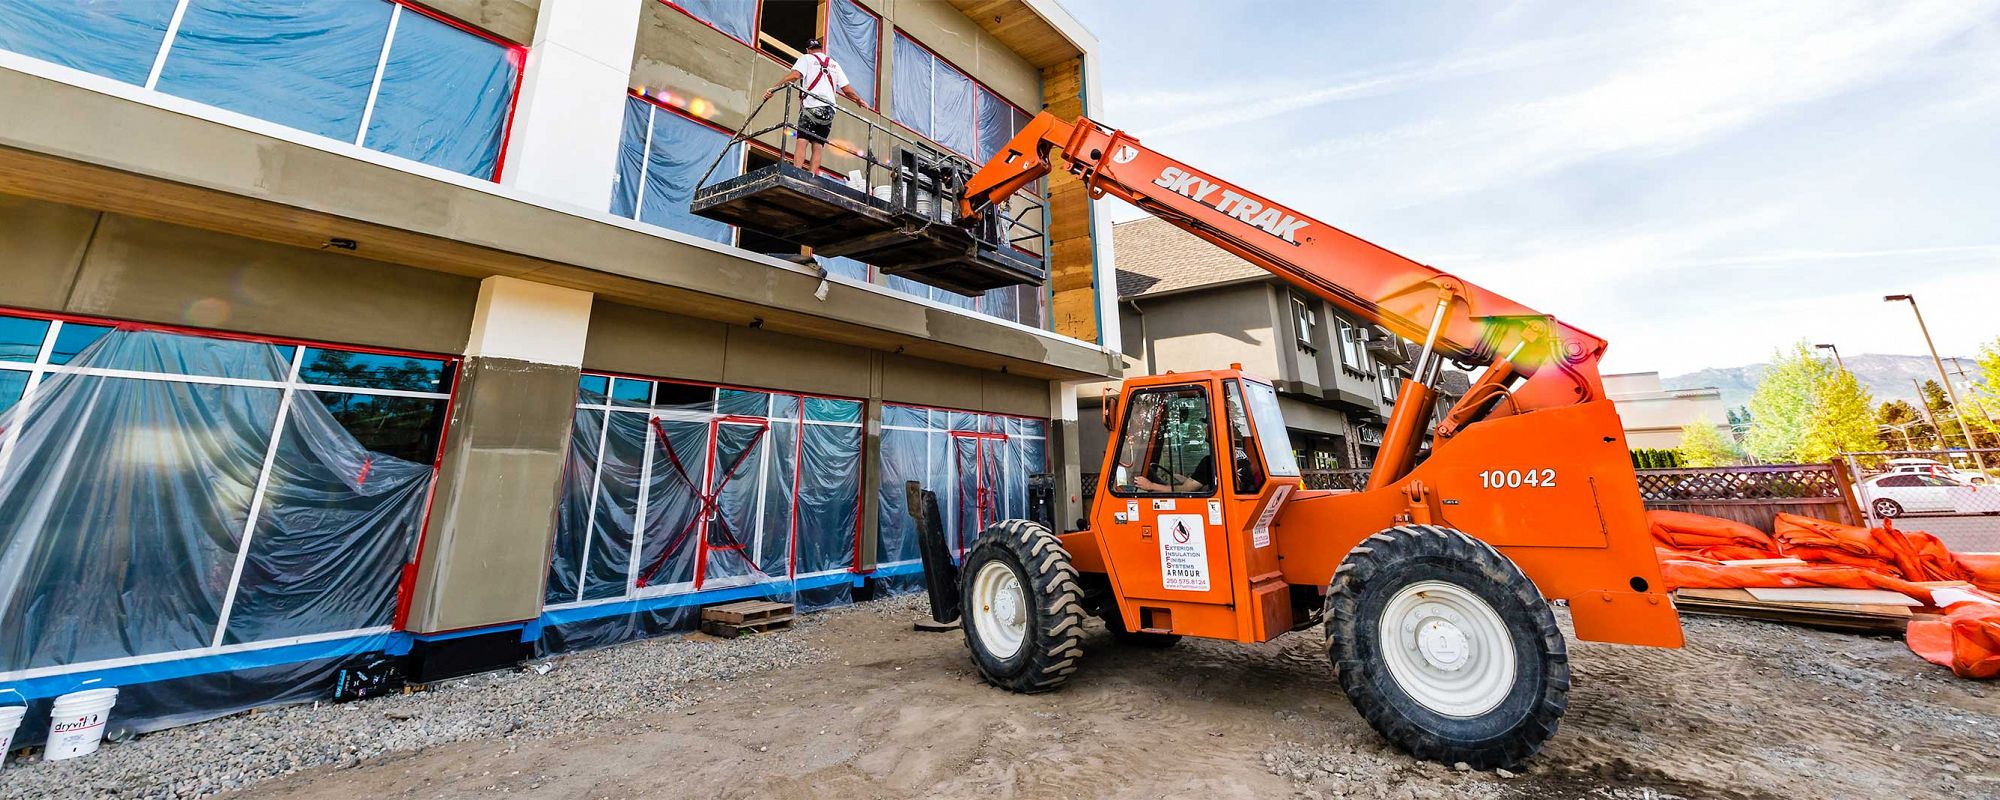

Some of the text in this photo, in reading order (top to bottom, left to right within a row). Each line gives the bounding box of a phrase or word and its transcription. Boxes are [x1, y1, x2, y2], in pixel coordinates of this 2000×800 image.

[1153, 166, 1311, 243] SKY TRAK
[1479, 468, 1557, 489] 10042
[1167, 569, 1201, 577] ARMOUR
[55, 716, 88, 732] dryvit
